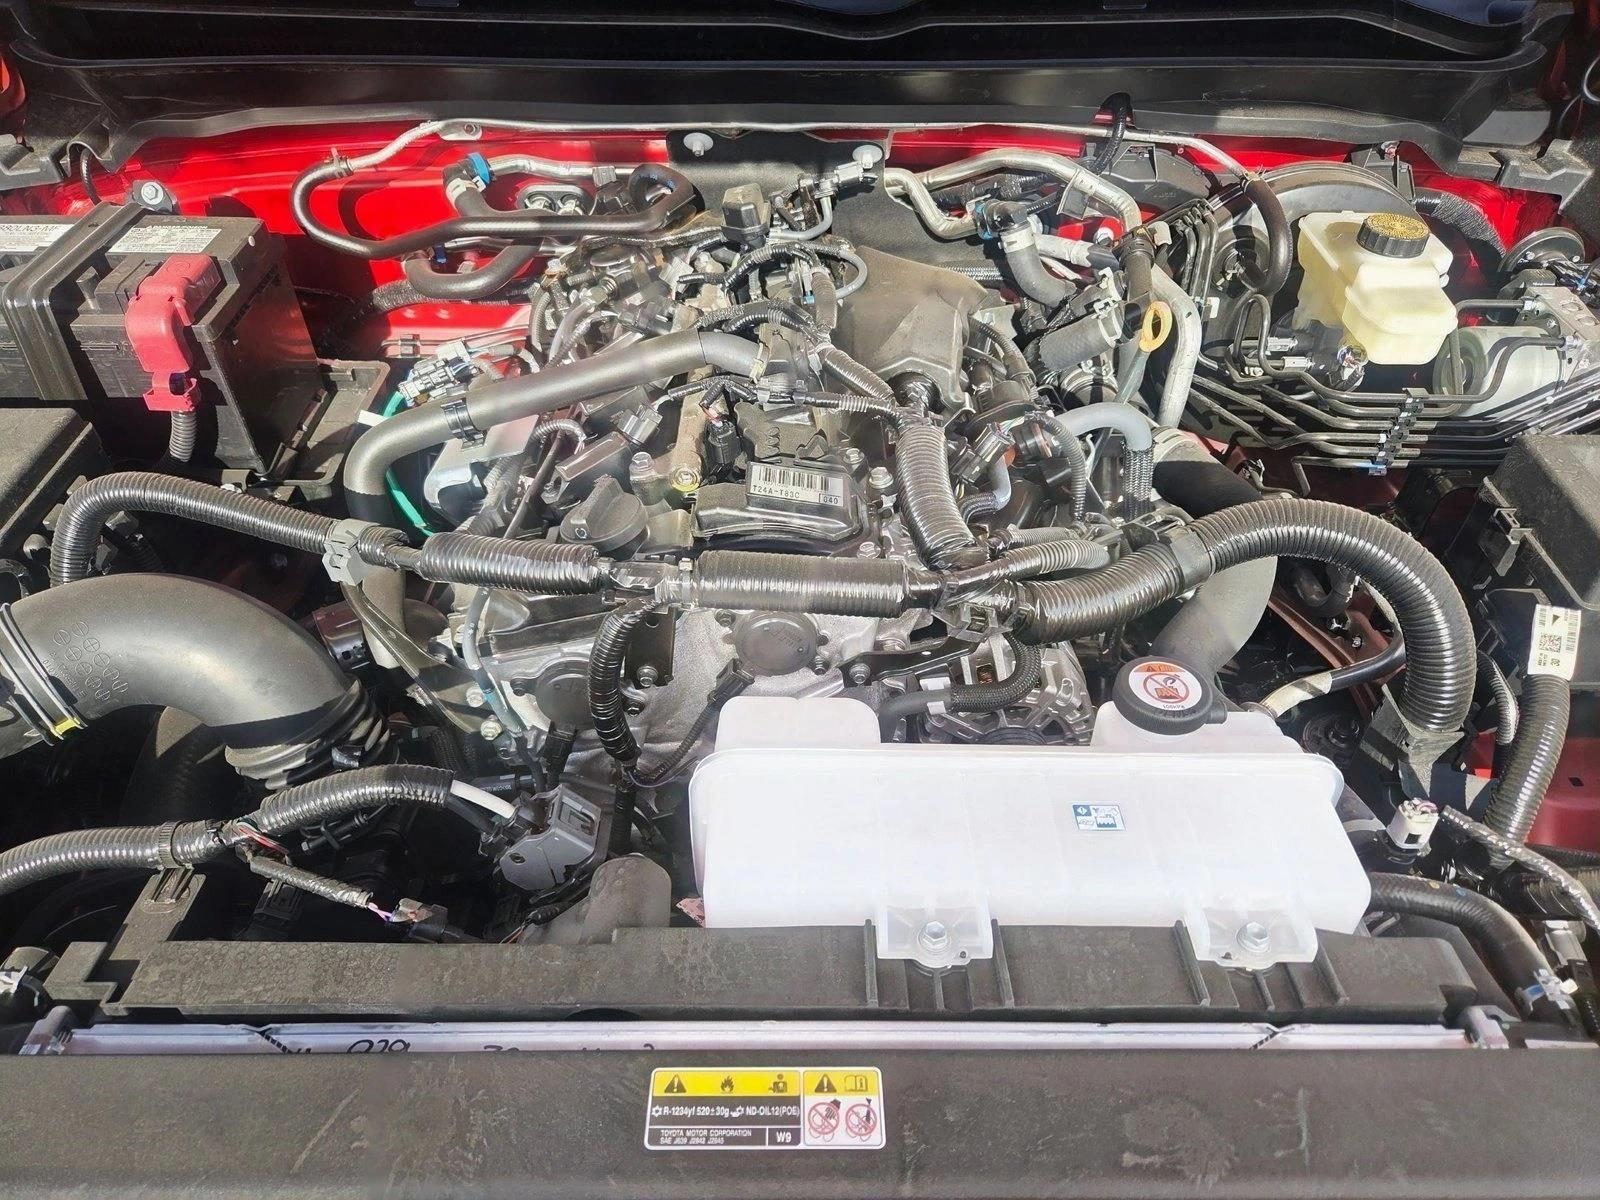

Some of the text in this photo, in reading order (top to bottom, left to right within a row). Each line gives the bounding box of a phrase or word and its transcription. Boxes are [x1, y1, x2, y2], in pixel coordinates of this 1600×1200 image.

[662, 1106, 695, 1117] R-1234yf
[660, 1129, 752, 1137] TOYOTA MOTOR CORPORATION
[776, 1131, 792, 1143] W9
